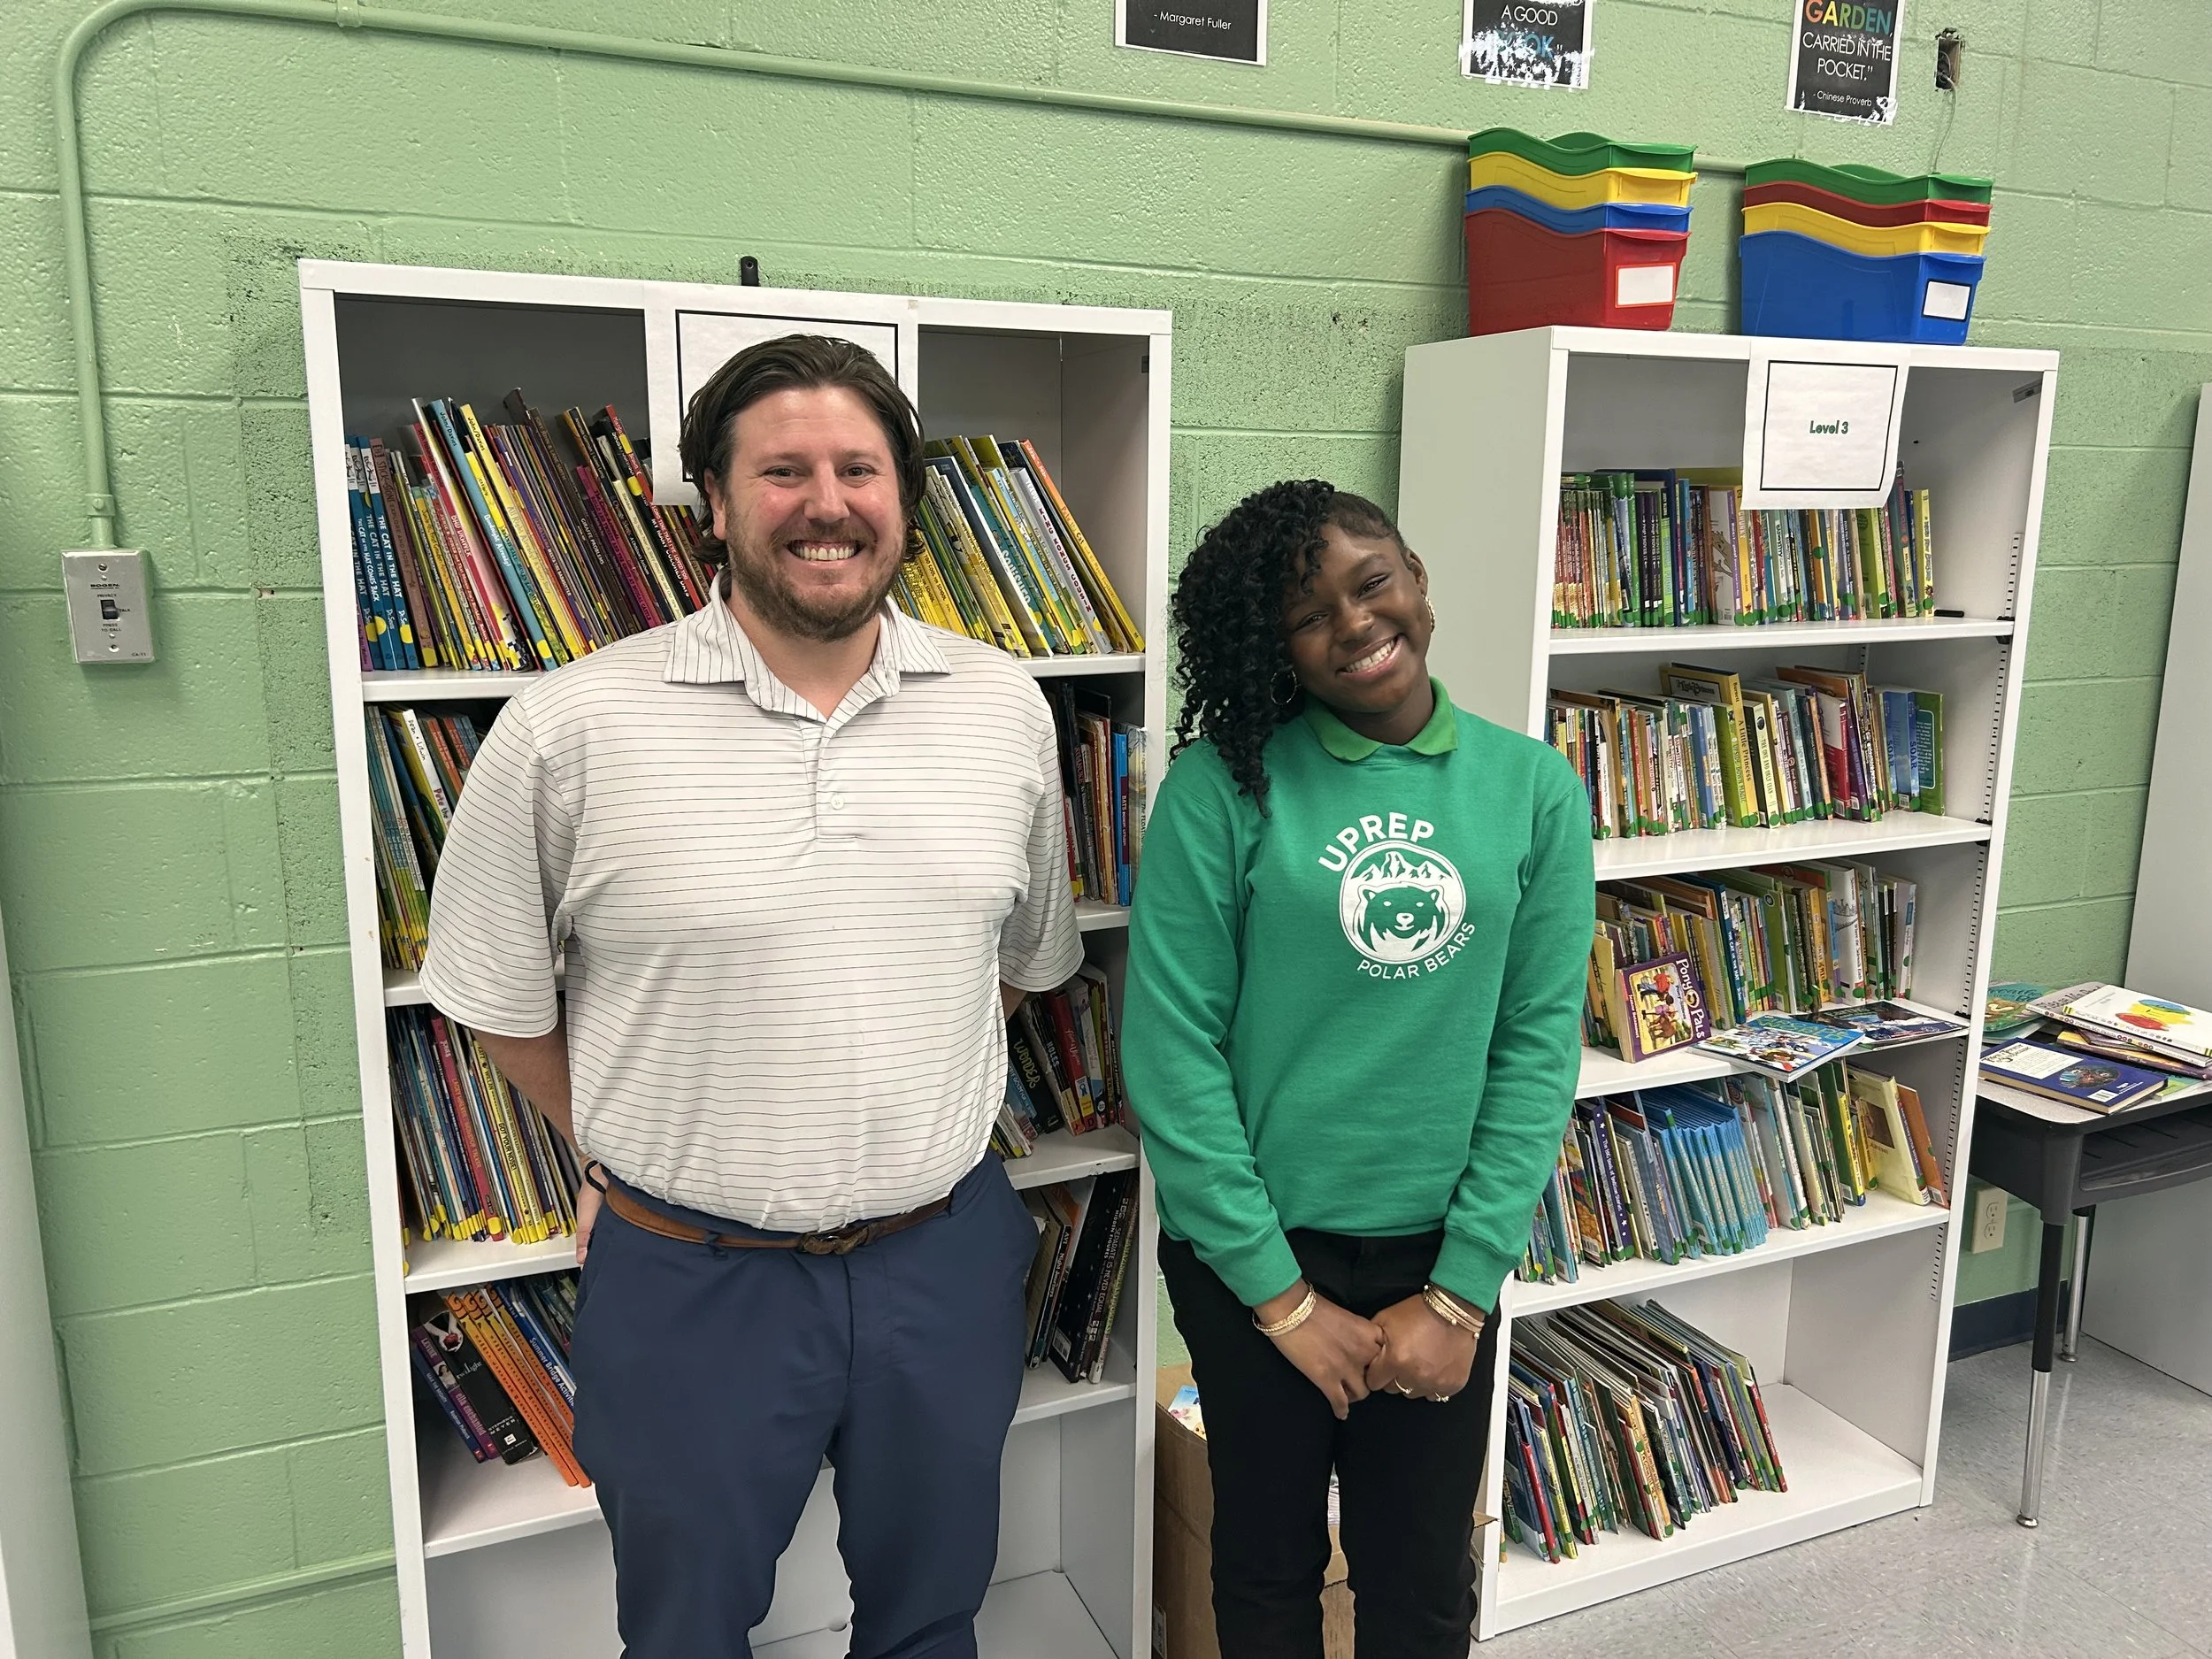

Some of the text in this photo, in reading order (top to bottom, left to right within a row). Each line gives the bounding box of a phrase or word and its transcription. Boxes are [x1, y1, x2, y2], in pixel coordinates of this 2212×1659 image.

[1160, 11, 1233, 31] Margaret Fuller
[1501, 4, 1559, 26] A GOOD
[1806, 0, 1893, 38] GARDEN,
[1803, 32, 1893, 62] CARRIED IN THE
[1817, 58, 1874, 81] POCKET."
[1816, 90, 1873, 108] Chinese Proverb
[1809, 420, 1849, 434] Level 3
[482, 513, 500, 543] Goodnight
[579, 517, 594, 540] GIRAFFE
[1058, 504, 1086, 546] Pete Cat
[365, 514, 391, 597] THE CAT IN THE HAT
[377, 515, 403, 599] THE CAT IN THE HAT
[495, 541, 512, 568] Already!
[588, 537, 606, 565] PROBLEMS
[650, 506, 661, 520] LONG
[657, 518, 666, 532] TIME
[662, 531, 672, 545] THAT
[672, 553, 685, 572] LOVED
[680, 569, 689, 580] YOU
[366, 565, 377, 584] COMES
[1036, 507, 1056, 534] KING
[1067, 573, 1093, 613] COUSIN
[357, 578, 367, 595] HAT
[915, 565, 936, 603] COOL SCHOOL
[922, 554, 948, 601] TOO COOL SCHOOL
[370, 583, 380, 603] BACK
[406, 718, 429, 761] Dean Litwin
[1738, 727, 1747, 749] Little
[1740, 749, 1752, 782] Princess
[432, 787, 451, 819] Pete the
[1737, 785, 1746, 803] MAGIC
[1318, 811, 1434, 872] UPREP
[1357, 922, 1476, 979] POLAR BEARS
[1675, 958, 1709, 1039] Pony Pals
[476, 1046, 495, 1091] KATZ WILLAN
[1011, 1036, 1042, 1089] WONDER
[1046, 1041, 1060, 1068] HOLES
[496, 1121, 518, 1171] GOT YOUR NOSE!
[1609, 1175, 1618, 1195] Bedtime
[1102, 1210, 1119, 1259] HIDDEN FIGURES
[1054, 1251, 1064, 1270] Night
[1099, 1269, 1111, 1292] NEVER
[1094, 1292, 1106, 1316] EQUAL
[420, 1336, 438, 1359] LEVINE
[527, 1336, 563, 1384] Summer Bridge
[456, 1360, 484, 1380] twilight
[454, 1392, 487, 1438] ella enchanted
[489, 1418, 516, 1434] MEYER
